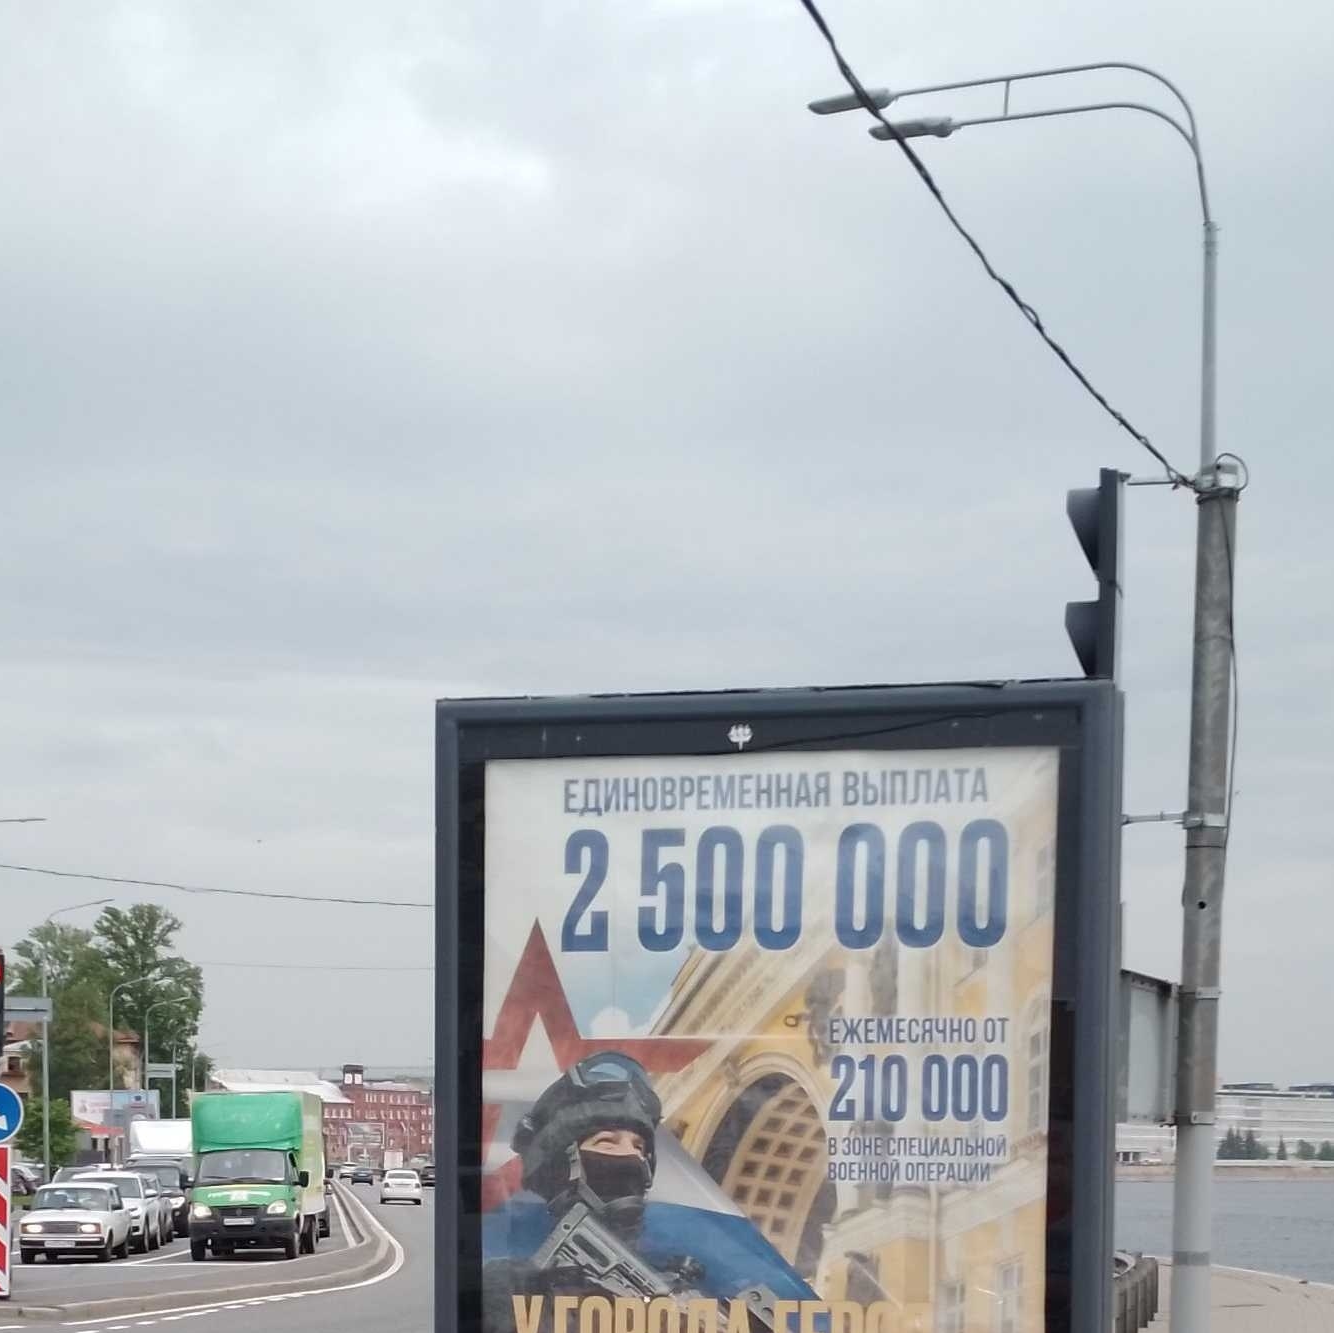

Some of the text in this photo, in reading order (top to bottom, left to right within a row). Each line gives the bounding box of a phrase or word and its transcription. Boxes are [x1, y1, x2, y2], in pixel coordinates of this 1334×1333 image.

[564, 767, 988, 816] ЕДИНОВРЕМЕННАЯ ВЫПЛАТА
[561, 819, 1009, 952] 2 500 000
[829, 1017, 1010, 1044] ЕЖЕМЕСЯЧНО ОТ
[828, 1054, 1009, 1122] 210 000
[828, 1134, 1006, 1159] В ЗОНЕ СПЕЦИАЛЬНОЙ
[828, 1160, 990, 1183] ВОЕННОЙ ОПЕРАЦИИ
